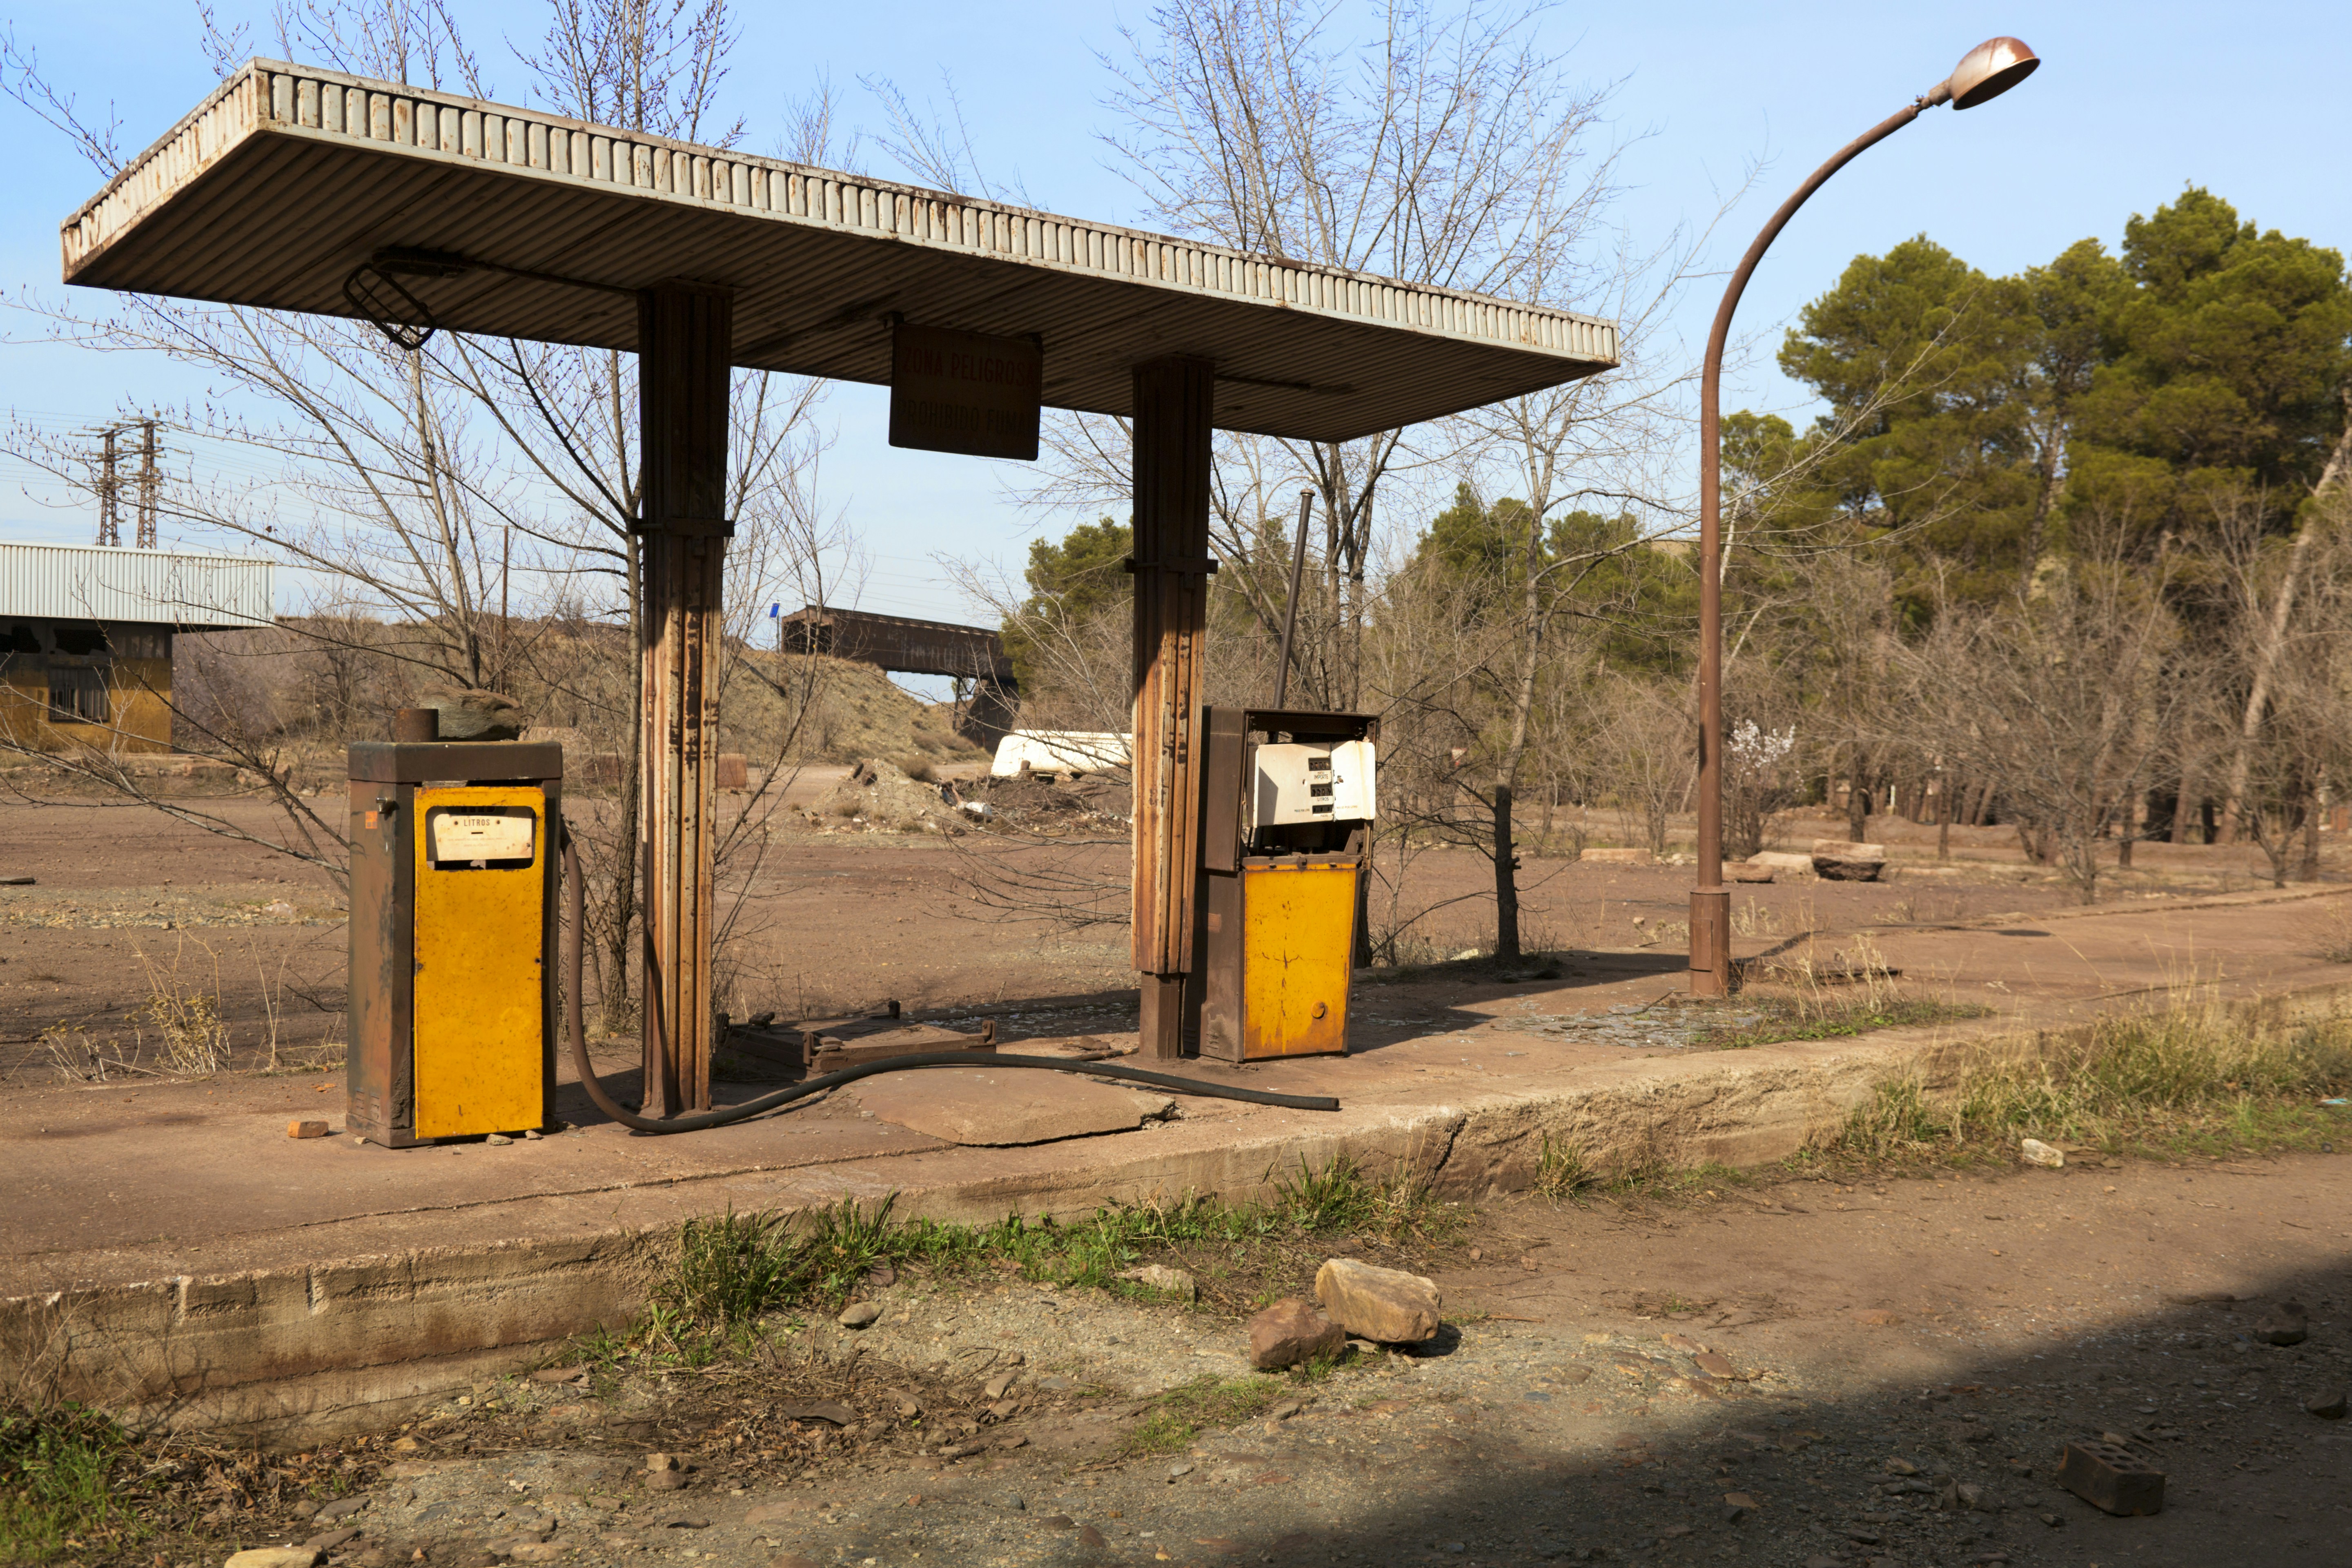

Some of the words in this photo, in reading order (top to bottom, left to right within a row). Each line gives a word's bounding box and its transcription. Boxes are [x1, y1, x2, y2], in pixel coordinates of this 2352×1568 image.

[903, 346, 943, 376] ZONA
[951, 352, 1035, 387] PELIGROSA
[898, 398, 979, 432] PROHIBIDO
